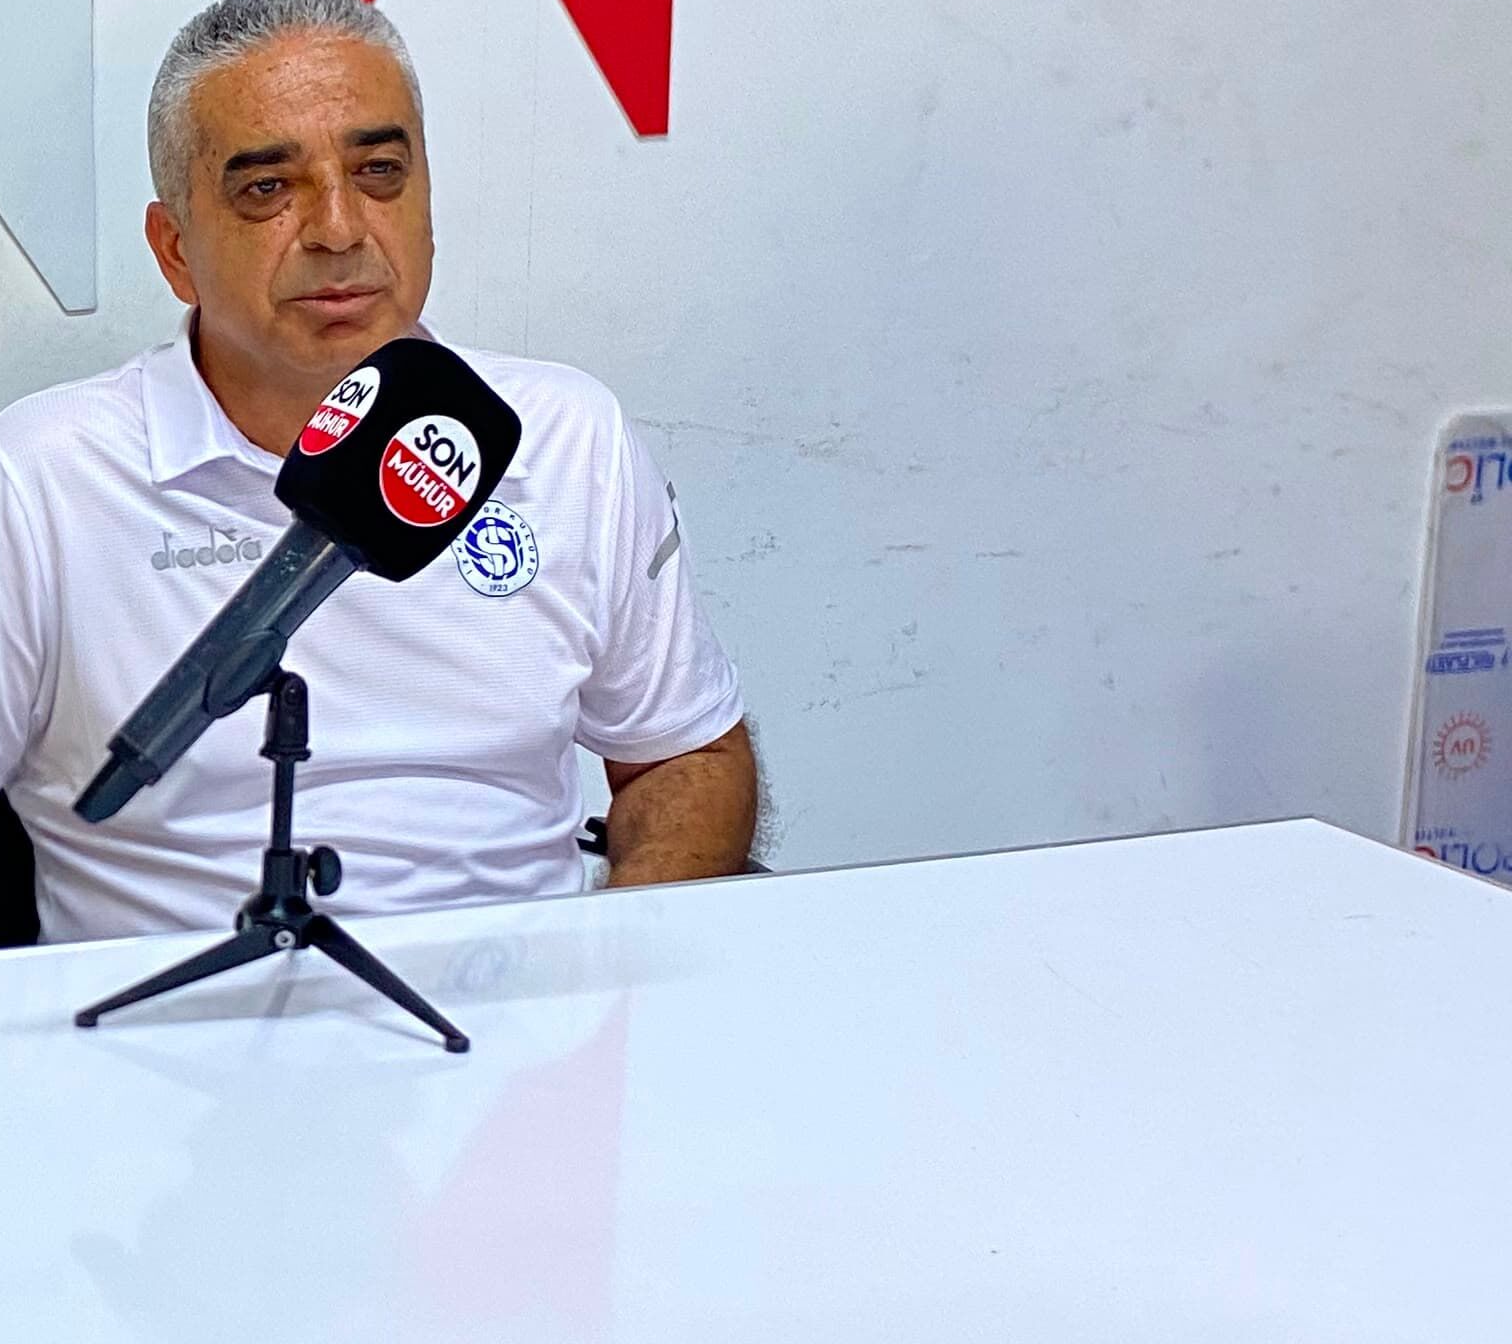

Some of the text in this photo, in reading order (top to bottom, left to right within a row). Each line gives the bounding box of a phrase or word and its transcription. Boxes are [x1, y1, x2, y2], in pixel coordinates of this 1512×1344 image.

[331, 379, 374, 408] SON
[414, 424, 476, 487] SON
[387, 448, 456, 518] MÜHÜR
[150, 523, 262, 571] diadora
[1450, 737, 1476, 755] UV
